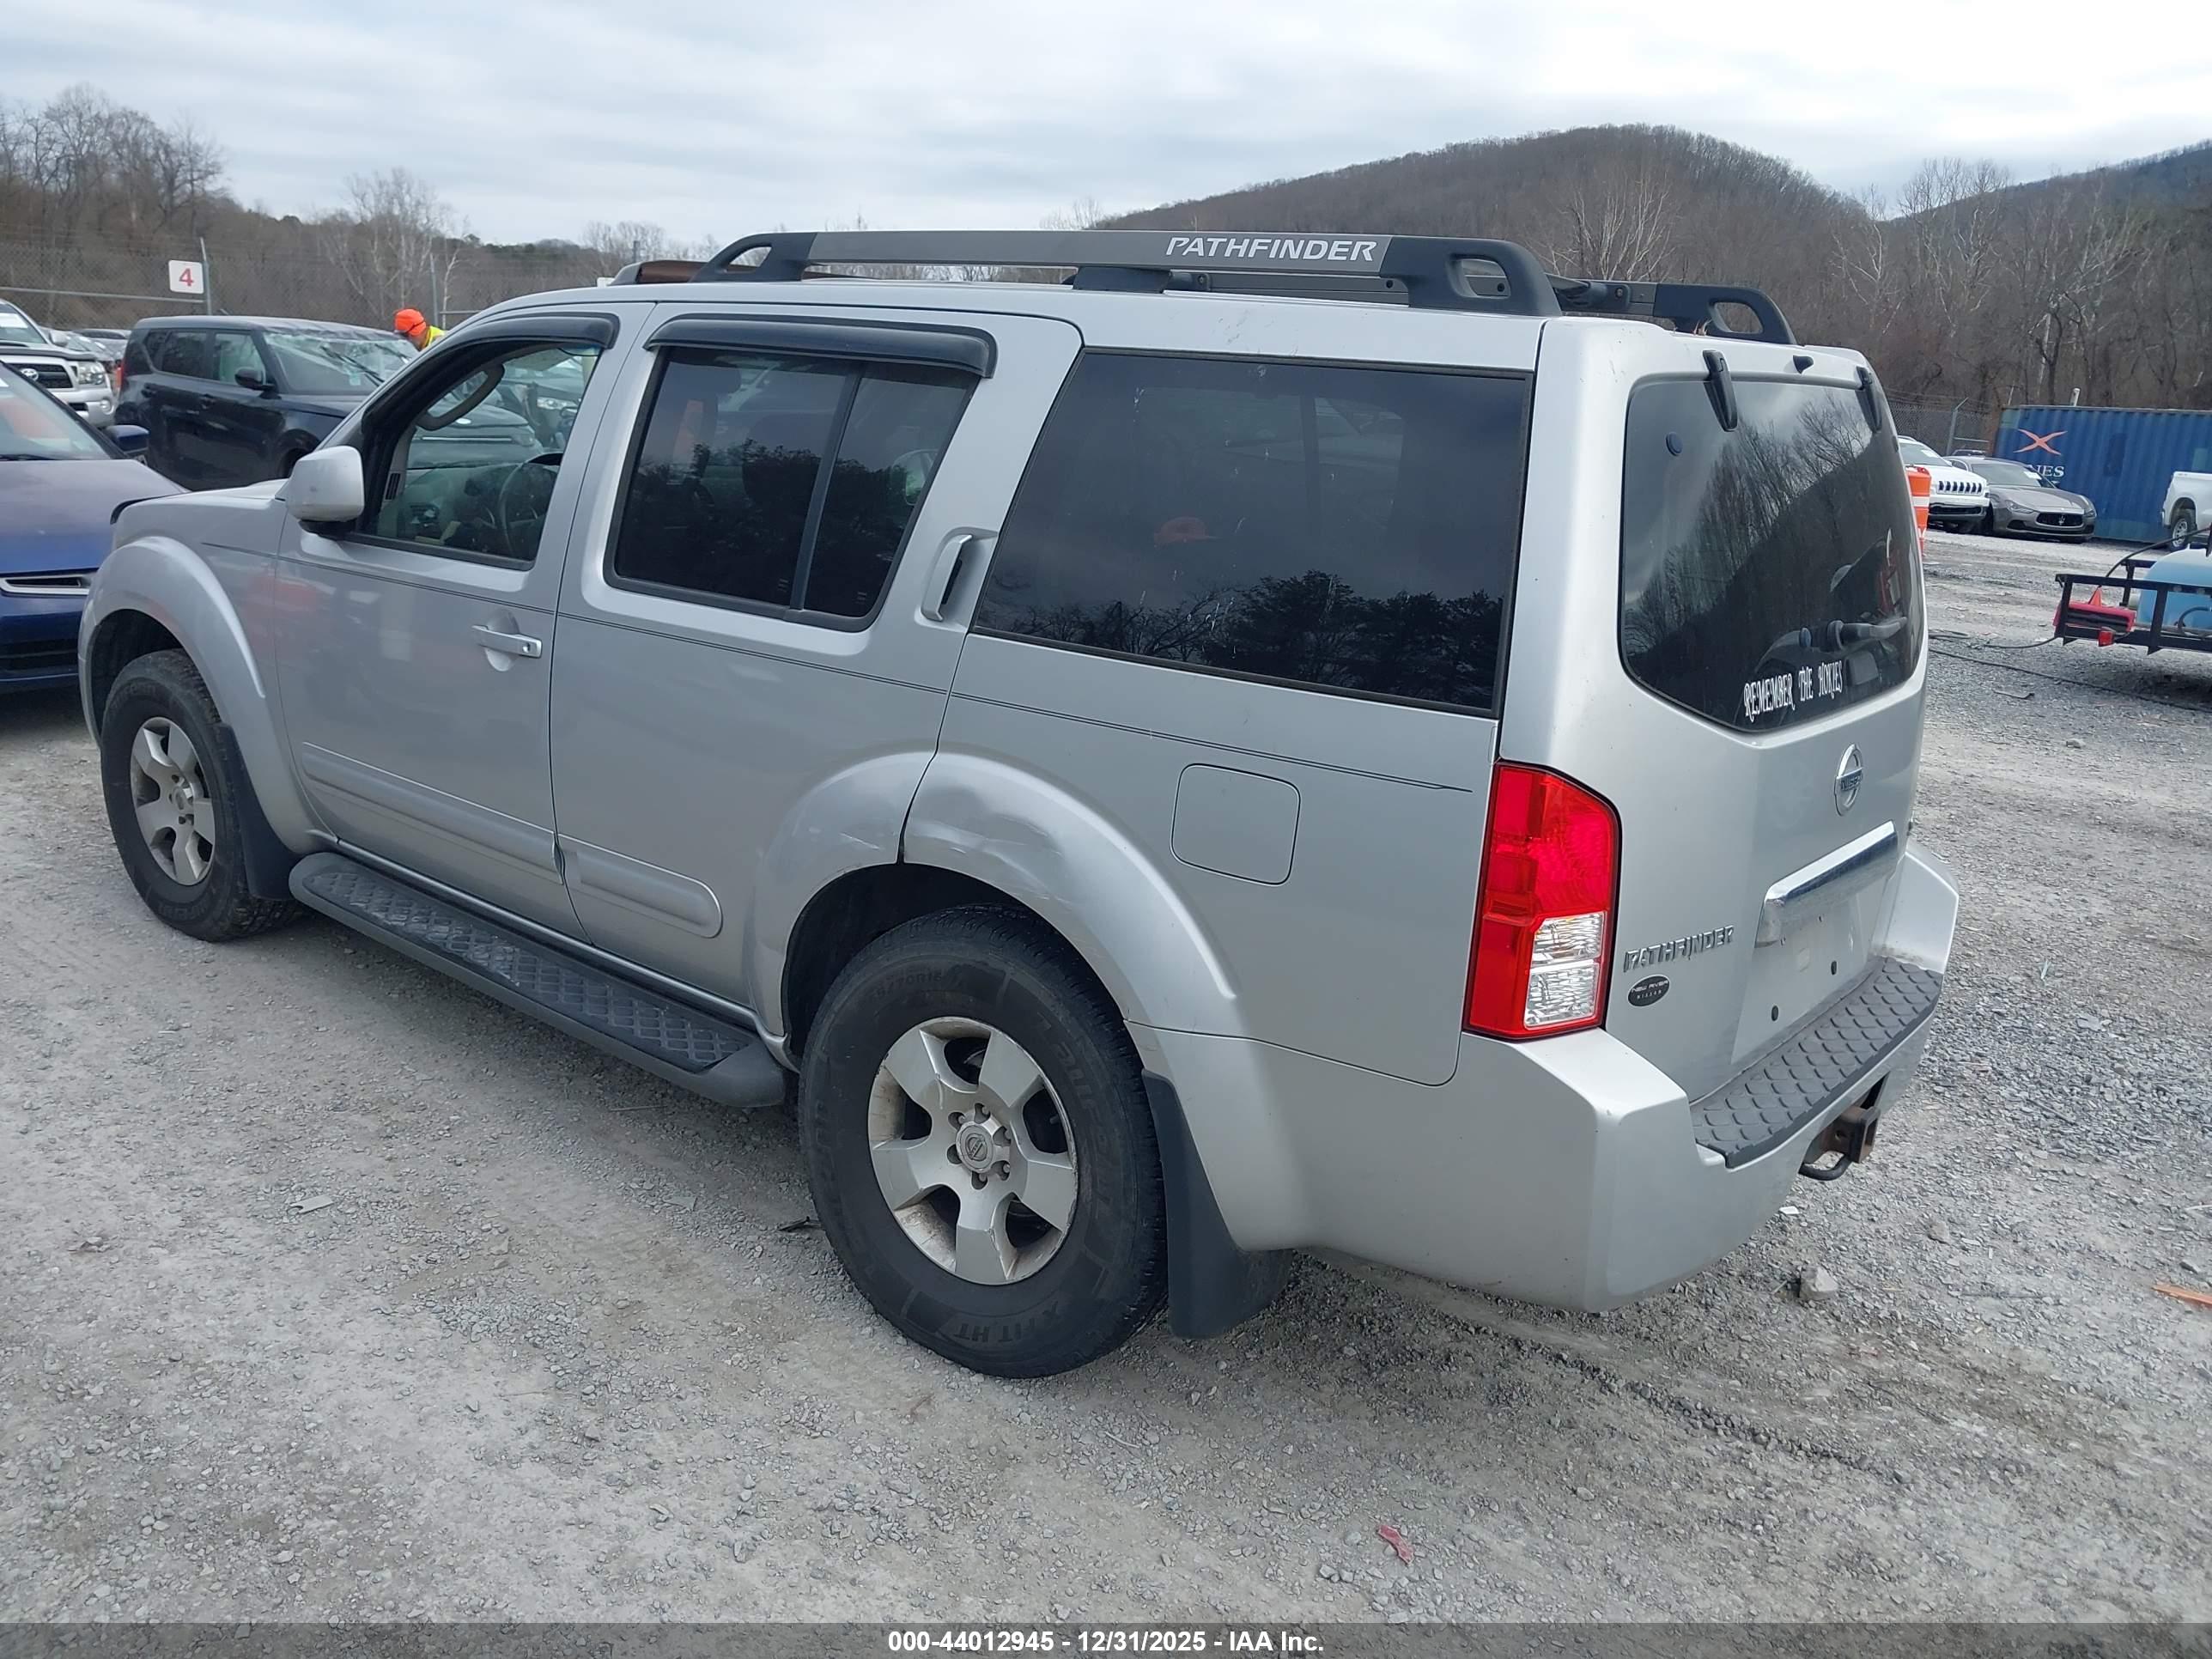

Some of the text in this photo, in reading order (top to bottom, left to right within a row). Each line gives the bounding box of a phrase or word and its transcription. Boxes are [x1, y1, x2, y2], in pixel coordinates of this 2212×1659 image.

[1165, 237, 1376, 262] PATHFINDER
[179, 268, 194, 287] 4
[1743, 659, 1843, 723] REMEMBER THE HOKIES
[1623, 925, 1734, 973] PATHFINDER
